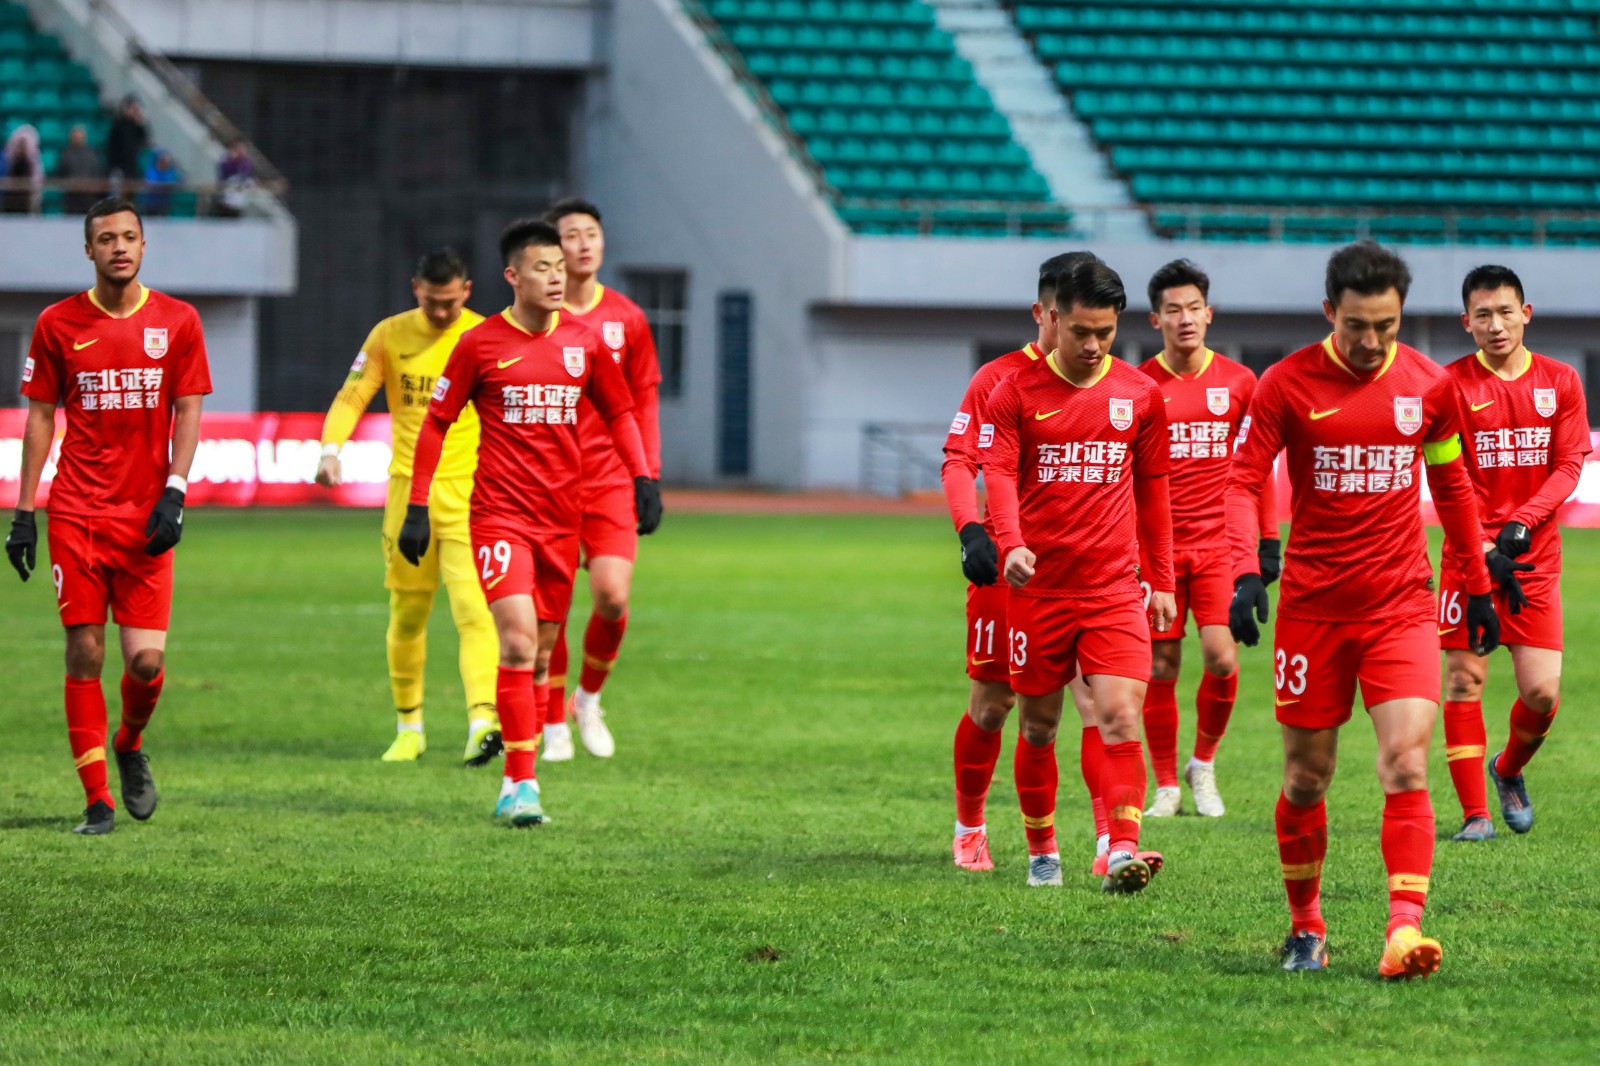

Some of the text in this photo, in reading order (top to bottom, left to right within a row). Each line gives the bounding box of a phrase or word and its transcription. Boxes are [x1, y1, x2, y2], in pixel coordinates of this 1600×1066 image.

[76, 368, 163, 391] 东北证券
[81, 391, 159, 410] 亚泰医药
[502, 384, 581, 406] 东北证券
[503, 406, 577, 424] 亚泰医药
[1474, 427, 1551, 450] 东北证券
[1037, 441, 1127, 465] 东北证券
[1313, 445, 1416, 471] 东北证券
[1476, 449, 1548, 469] 亚泰医药
[1037, 465, 1122, 483] 亚泰医药
[1313, 470, 1412, 493] 亚泰医药
[478, 540, 511, 579] 29
[1440, 590, 1462, 624] 16
[975, 618, 995, 655] 11
[1009, 627, 1027, 666] 13
[1275, 648, 1308, 695] 33
